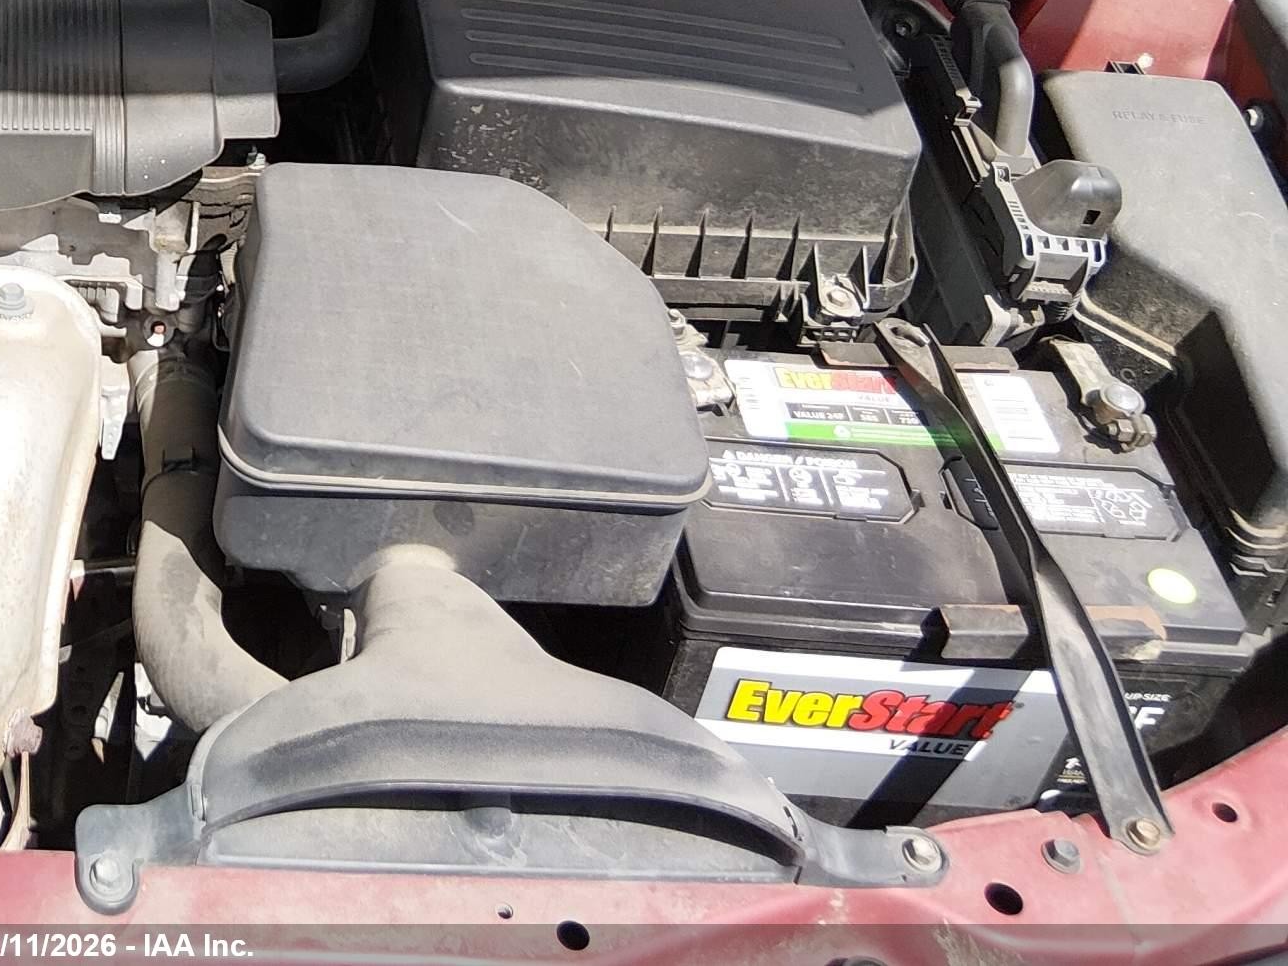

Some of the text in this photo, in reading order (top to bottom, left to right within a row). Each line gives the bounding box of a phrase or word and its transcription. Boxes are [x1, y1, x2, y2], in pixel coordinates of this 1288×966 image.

[772, 366, 897, 395] EverStart
[725, 678, 1015, 740] EverStart
[889, 738, 970, 756] VALUE
